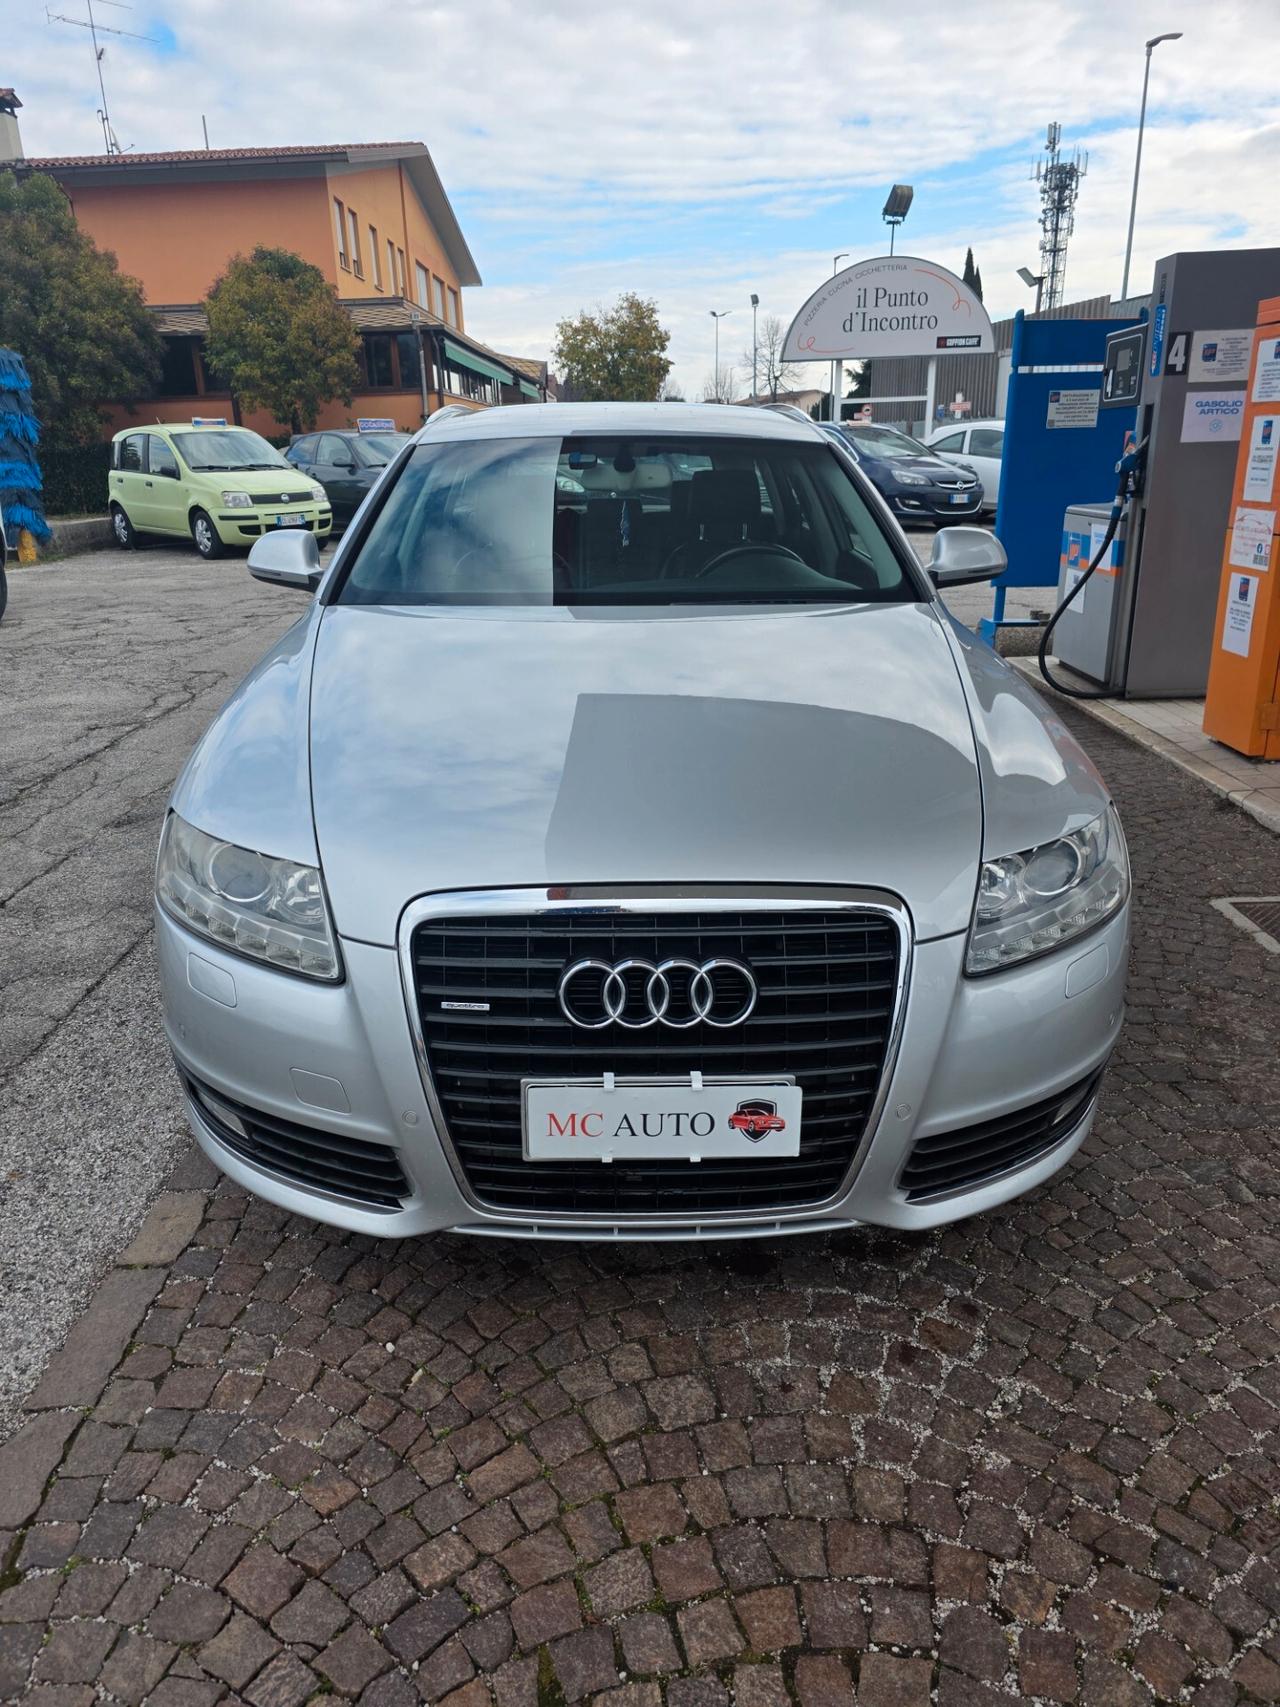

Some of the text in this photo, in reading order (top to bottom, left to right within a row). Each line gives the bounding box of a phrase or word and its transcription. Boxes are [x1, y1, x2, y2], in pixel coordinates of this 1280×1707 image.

[803, 264, 908, 326] PIZZERIA CUCINA CICCHETTERIA
[856, 287, 929, 309] il Punto
[842, 312, 939, 333] d'Incontro
[1168, 334, 1187, 372] 4
[1106, 368, 1114, 398] 4
[1195, 400, 1243, 408] GASOLIO
[1199, 408, 1240, 416] ARTICO
[546, 1111, 716, 1138] MC AUTO
